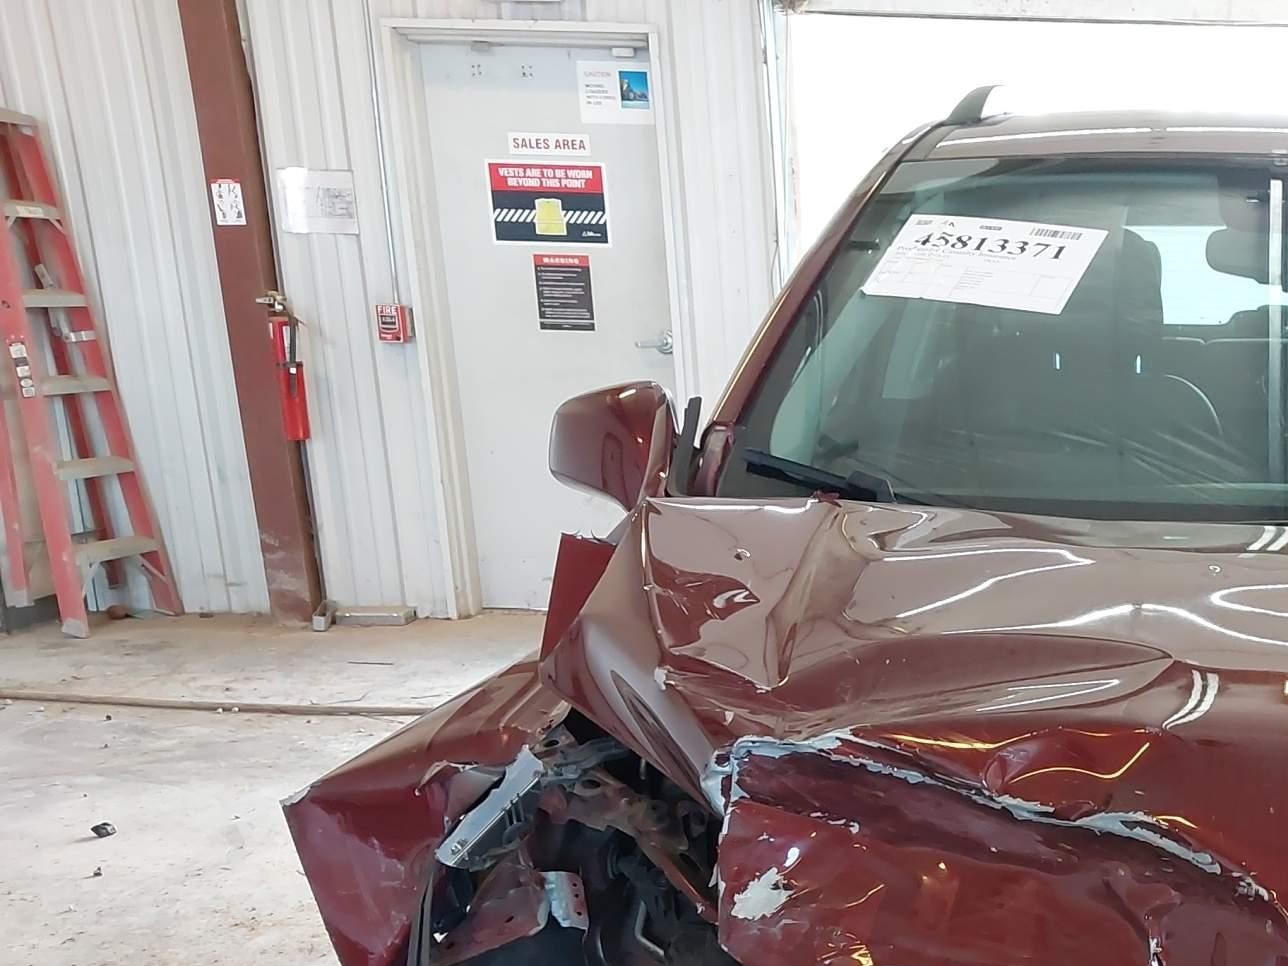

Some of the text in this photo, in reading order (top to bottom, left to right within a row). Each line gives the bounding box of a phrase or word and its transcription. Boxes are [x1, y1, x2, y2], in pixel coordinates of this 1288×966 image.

[513, 137, 586, 151] SALES AREA
[498, 167, 593, 179] VESTS ARE TO BE WORN
[507, 177, 586, 189] BEYOND THIS POINT
[915, 231, 1067, 260] 45813371
[377, 305, 397, 315] FIRE
